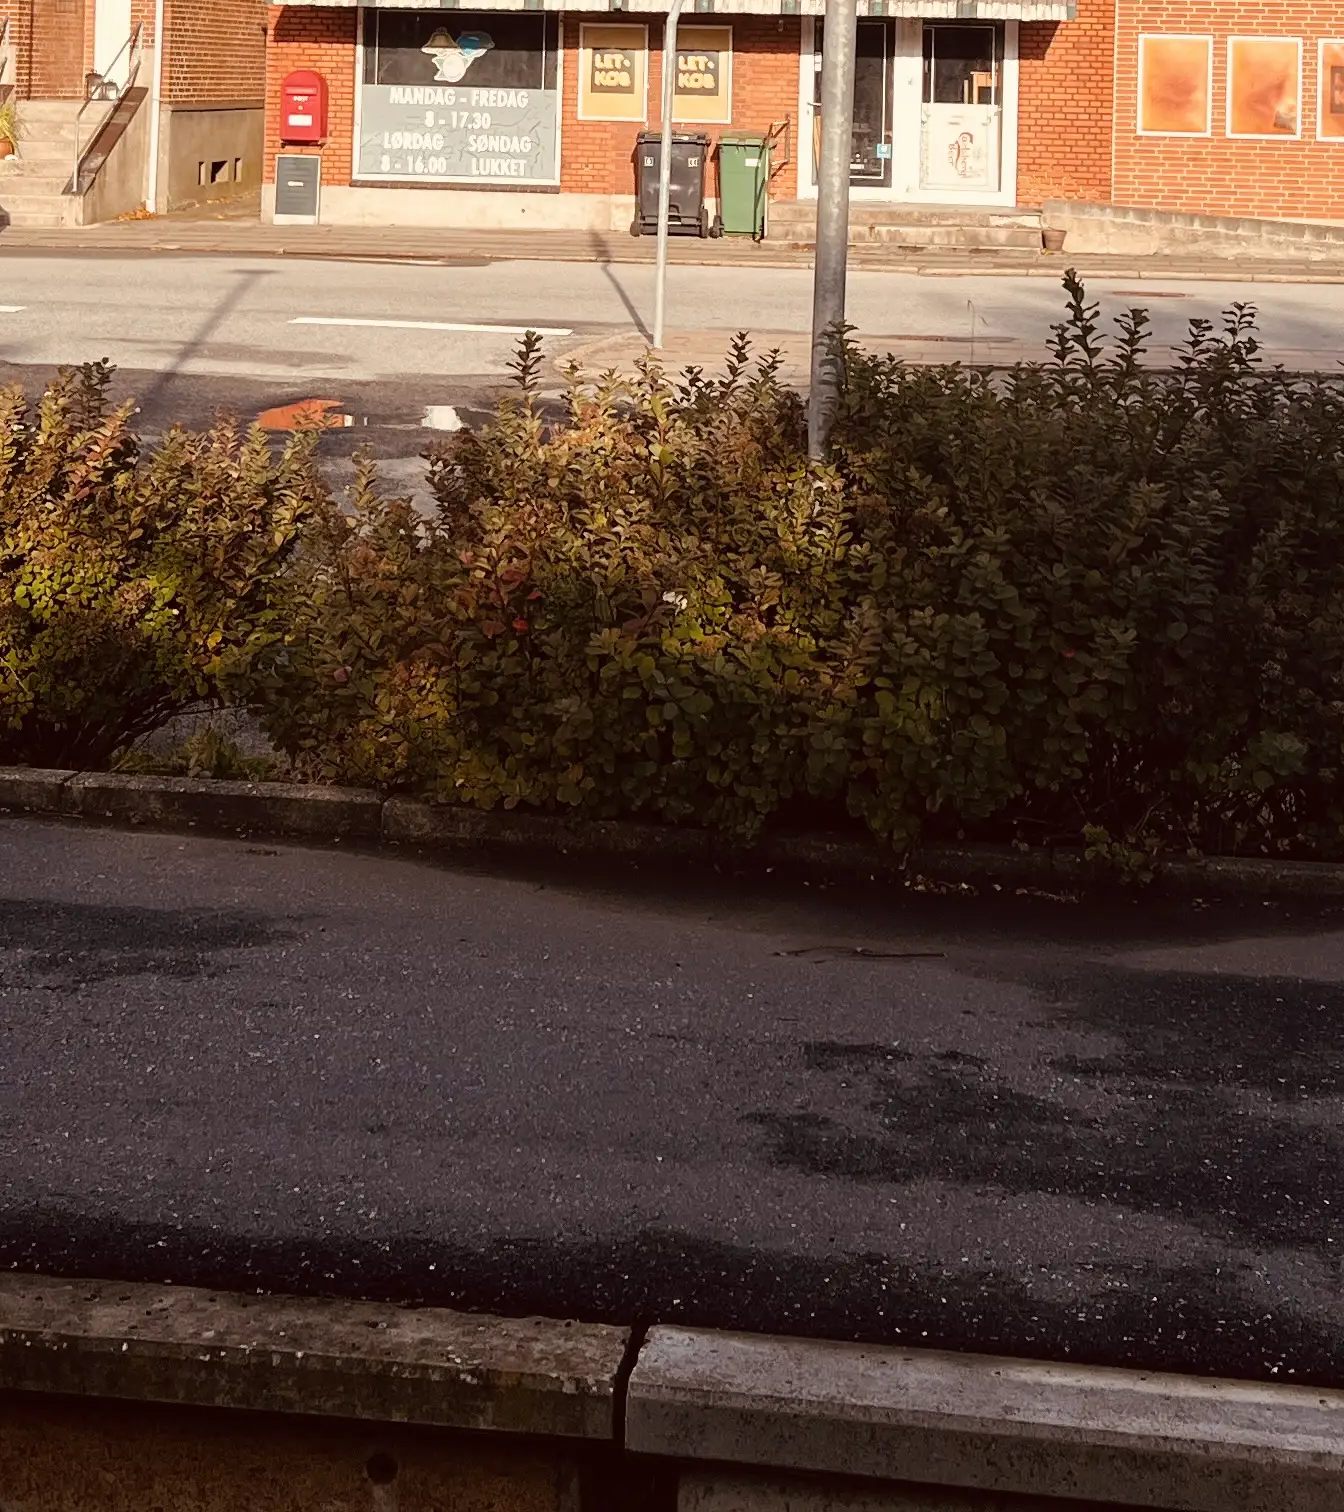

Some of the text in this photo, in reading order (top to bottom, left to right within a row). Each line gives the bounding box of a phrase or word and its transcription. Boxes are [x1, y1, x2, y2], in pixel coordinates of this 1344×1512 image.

[389, 87, 456, 106] MANDAG
[471, 90, 529, 108] FREDAG
[424, 110, 435, 128] 8
[451, 111, 491, 130] 17.30
[383, 131, 445, 150] LØRDAG
[469, 134, 532, 153] SØNDAG
[381, 154, 391, 172] 8
[407, 155, 447, 174] 16.00
[471, 157, 528, 176] LUKKET
